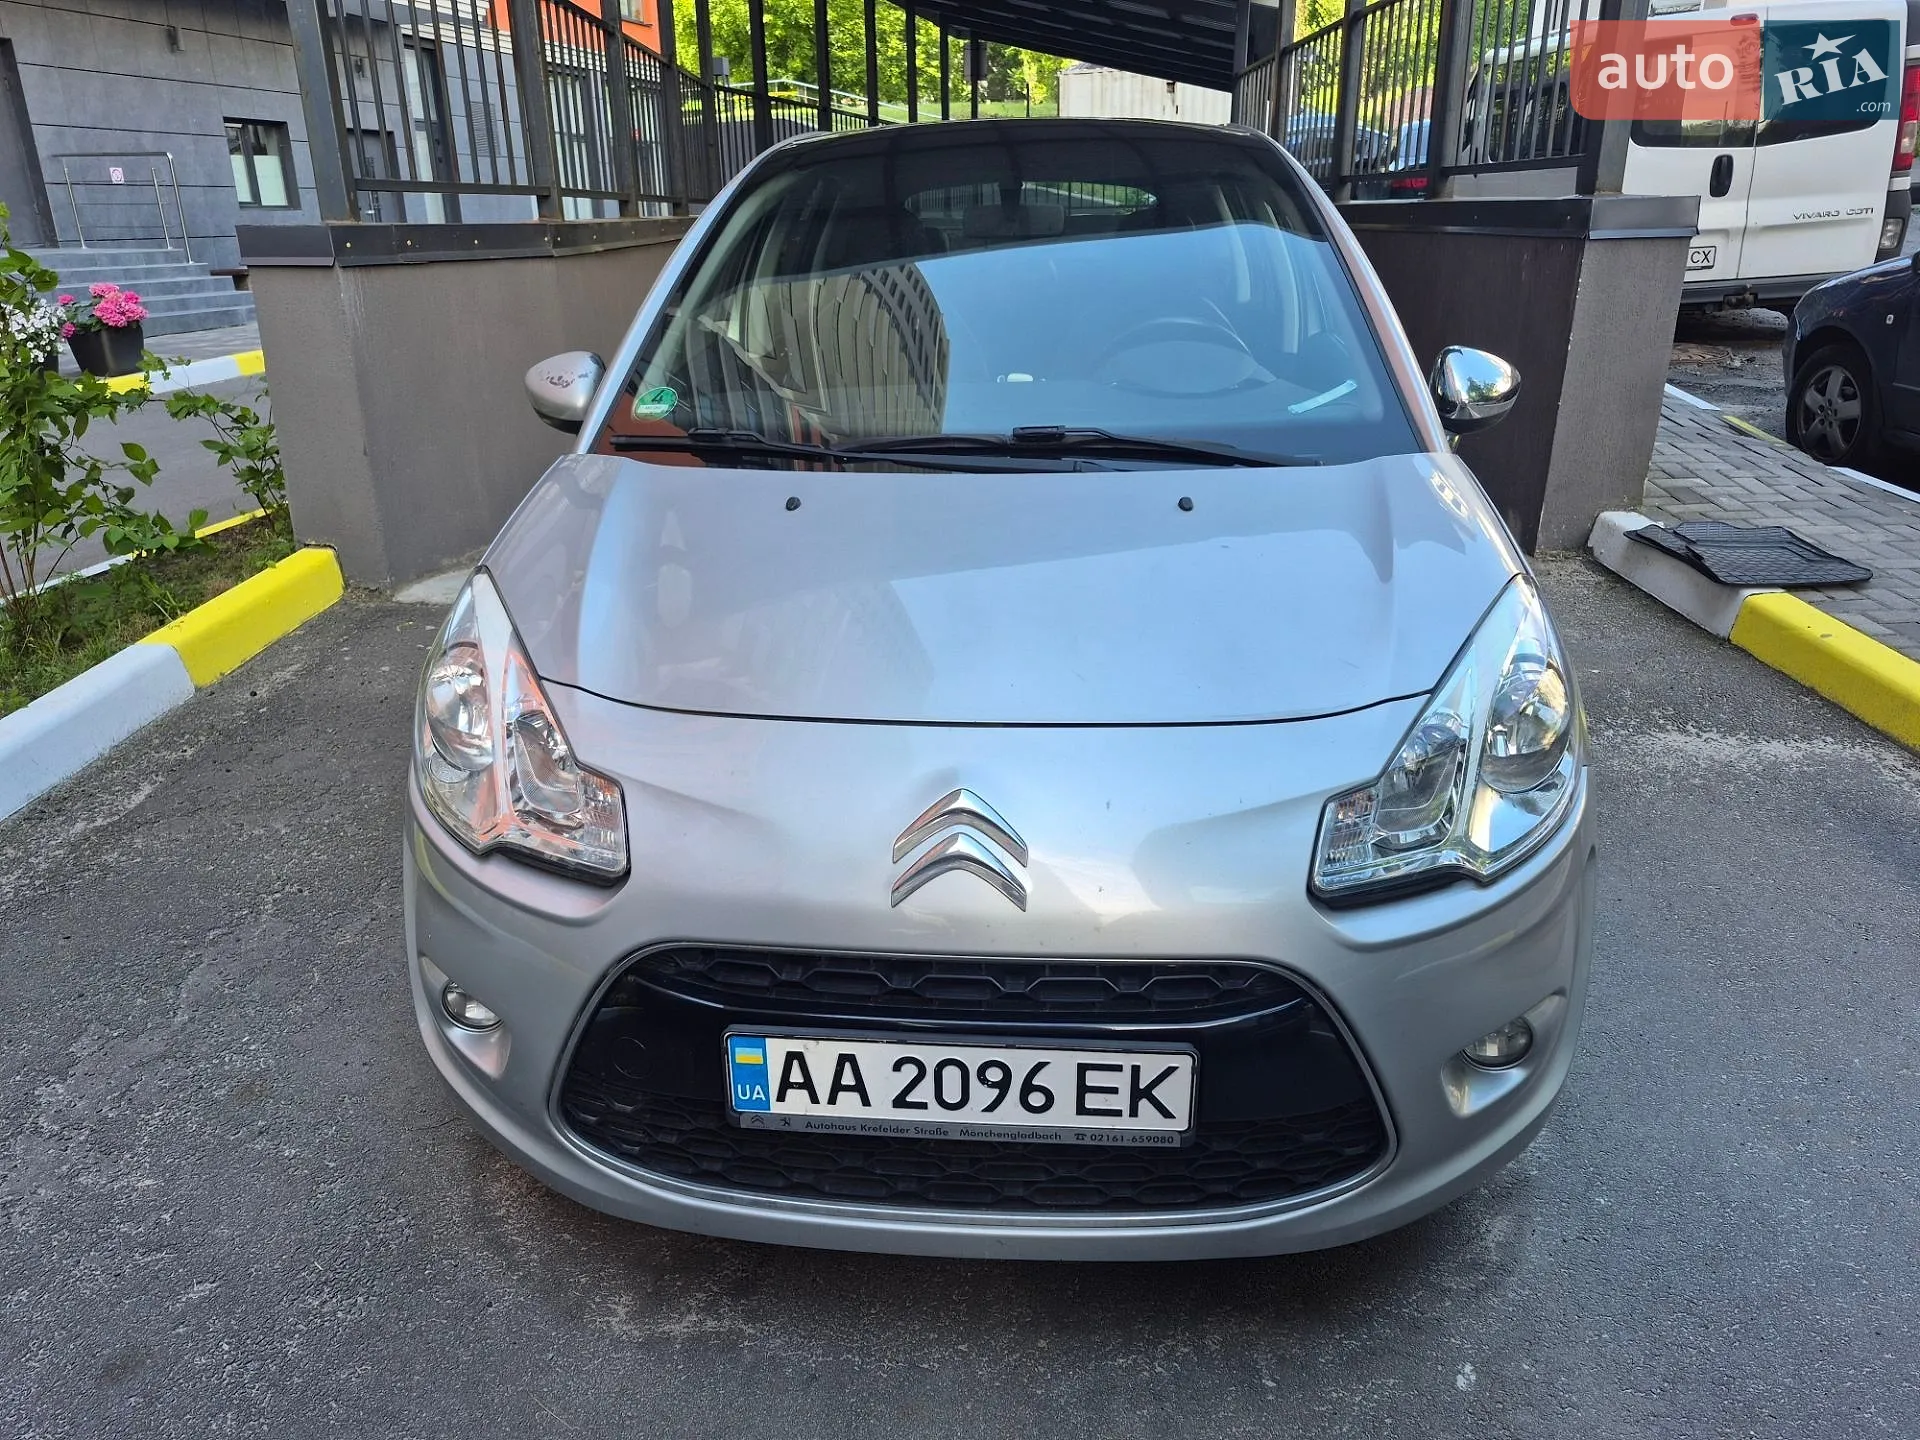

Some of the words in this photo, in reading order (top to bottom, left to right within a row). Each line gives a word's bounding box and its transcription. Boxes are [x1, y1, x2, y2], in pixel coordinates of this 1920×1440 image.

[1793, 210, 1840, 220] VIVARO
[1690, 250, 1711, 264] CX
[651, 389, 665, 404] 4
[737, 1083, 766, 1101] UA
[775, 1050, 872, 1107] AA
[891, 1056, 1056, 1114] 2096
[1075, 1062, 1180, 1119] EK
[805, 1121, 857, 1132] Autohaus
[860, 1124, 910, 1135] Krefelder
[914, 1126, 949, 1137] Straße
[959, 1128, 1062, 1142] Mönchengladbach
[1090, 1134, 1174, 1145] 02161-659080
